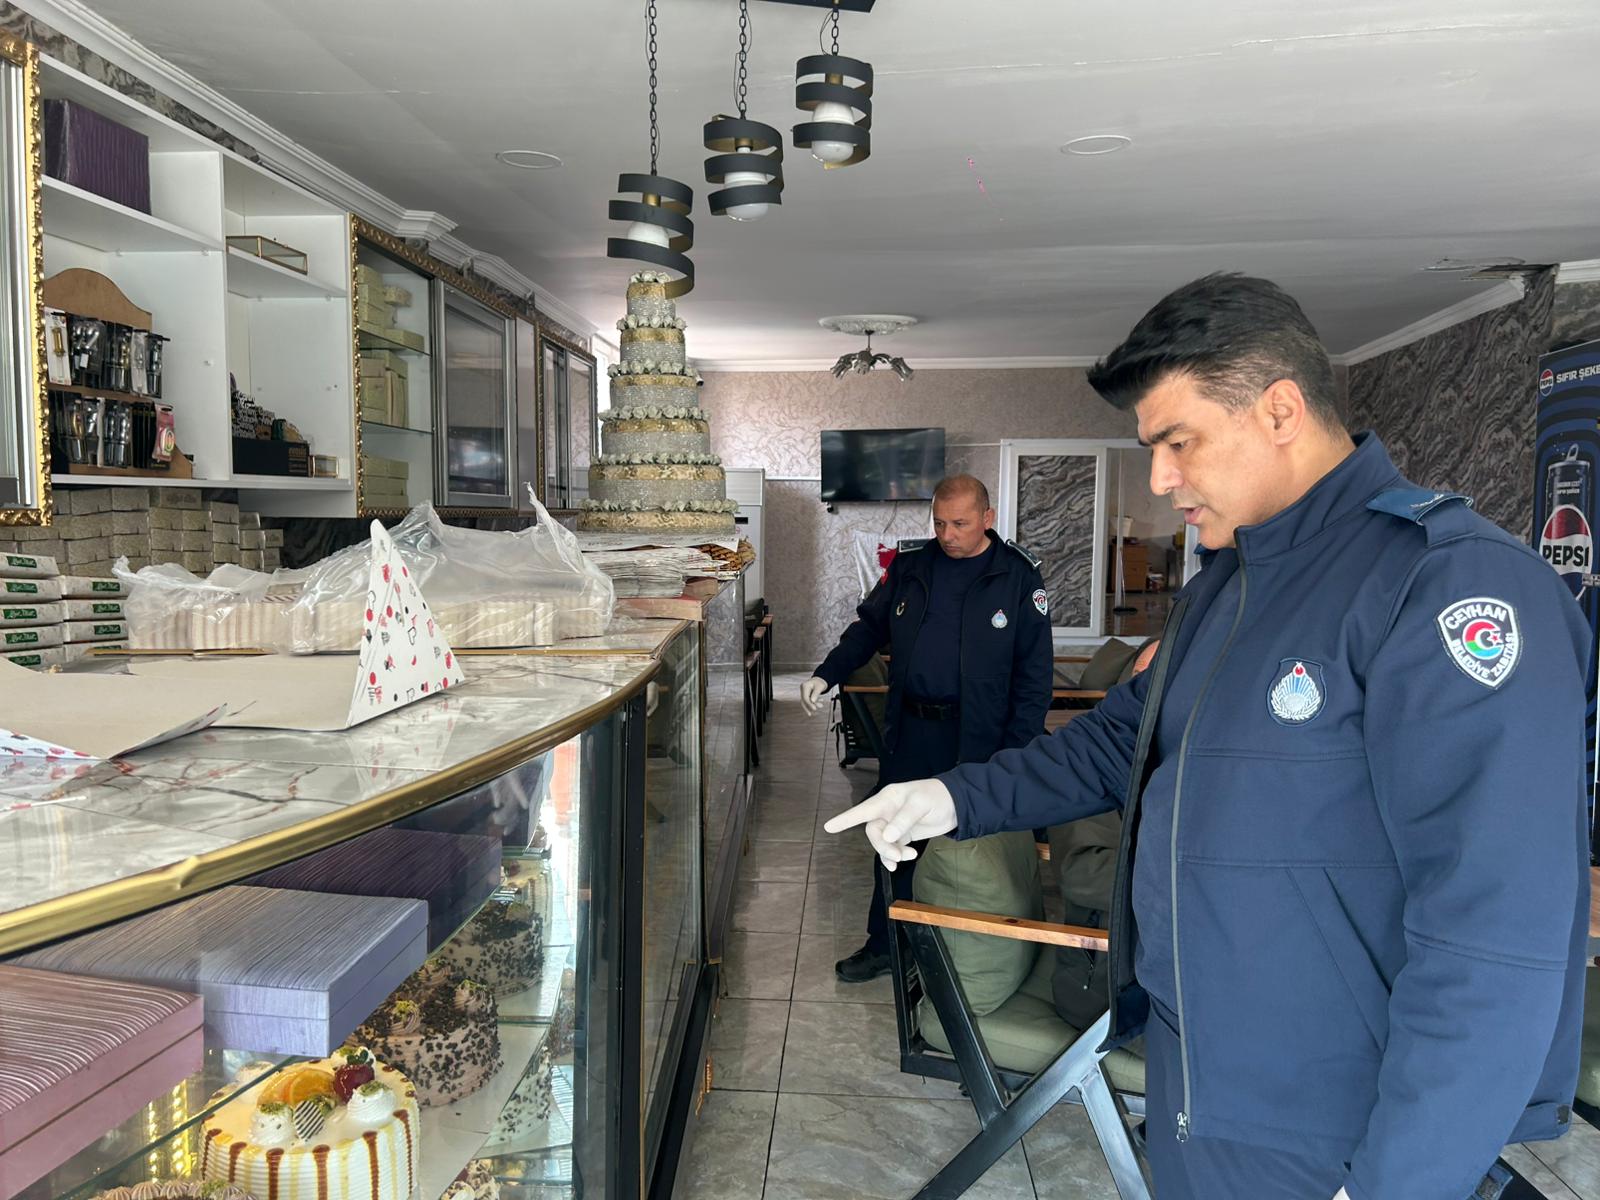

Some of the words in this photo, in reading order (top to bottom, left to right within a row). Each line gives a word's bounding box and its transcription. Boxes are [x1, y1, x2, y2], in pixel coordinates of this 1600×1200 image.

[1556, 370, 1577, 383] SIFIR
[1542, 544, 1590, 567] PEPSI
[1445, 603, 1507, 629] CEYHAN
